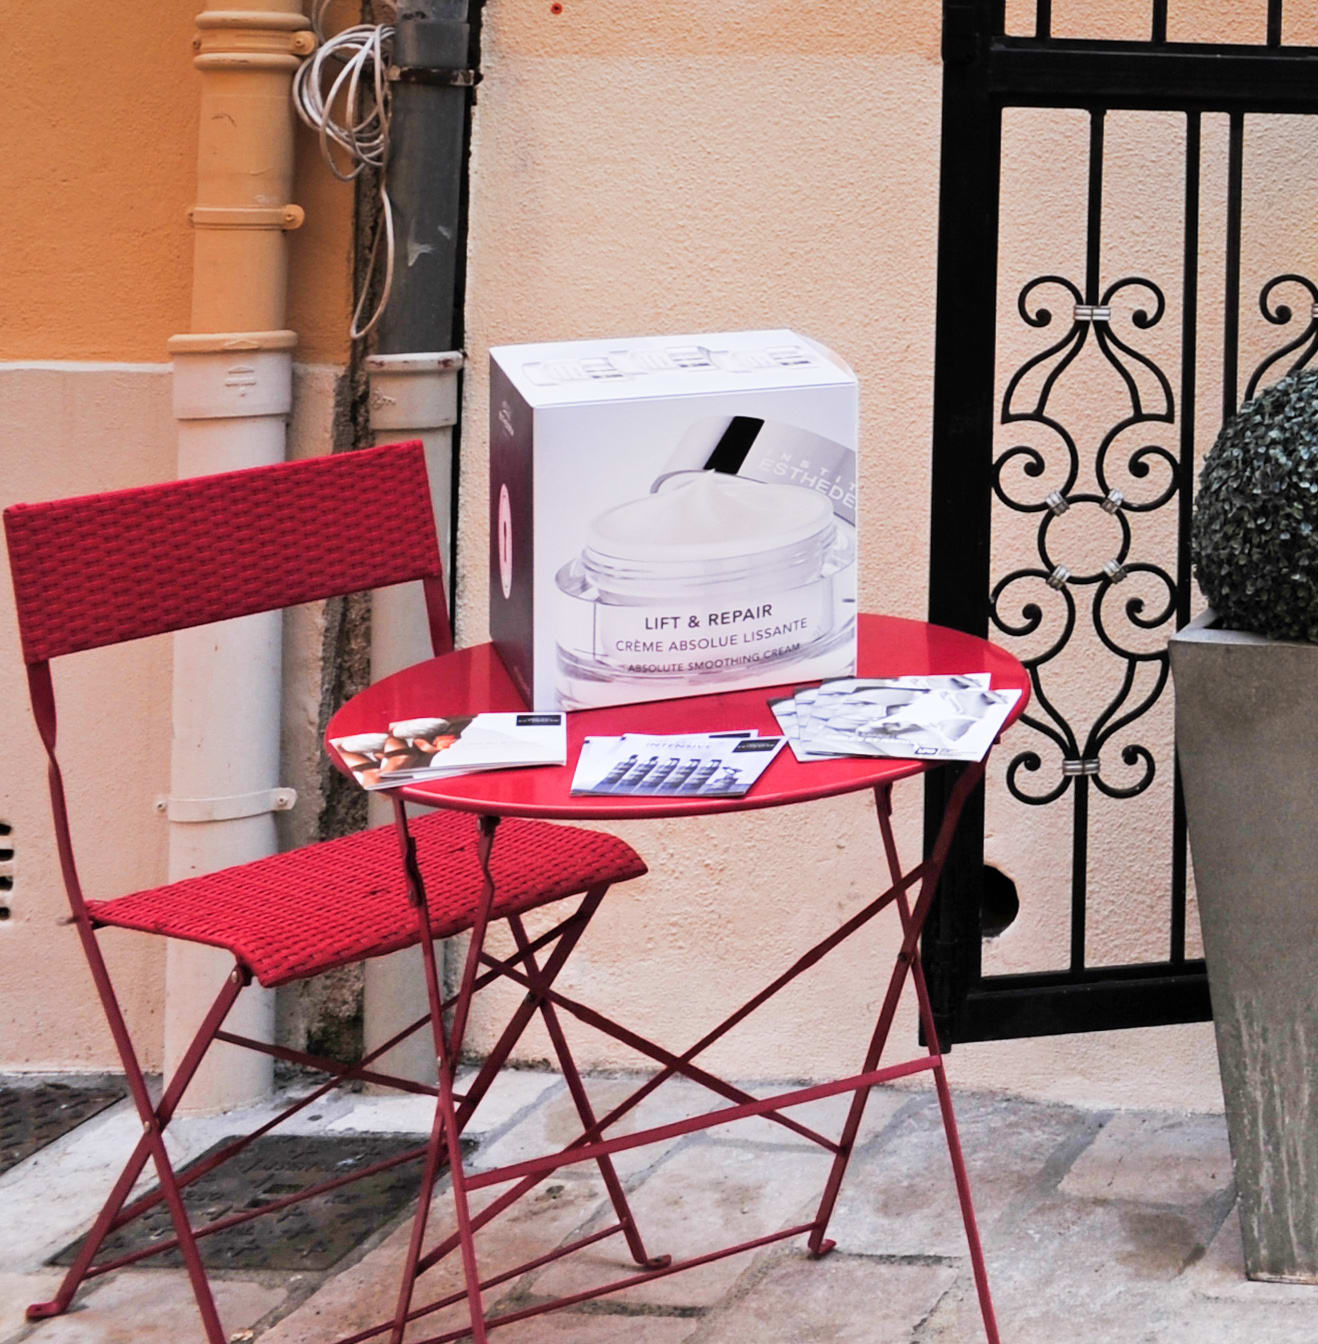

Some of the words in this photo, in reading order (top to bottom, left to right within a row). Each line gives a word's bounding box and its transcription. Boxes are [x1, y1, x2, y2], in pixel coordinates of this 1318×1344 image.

[645, 616, 680, 630] LIFT
[688, 615, 700, 628] &
[708, 604, 773, 626] REPAIR
[616, 639, 663, 652] CRÈME
[668, 634, 738, 651] ABSOLUE
[743, 617, 808, 643] LISSANTE
[628, 662, 684, 673] ABSOLUTE
[687, 652, 760, 672] SMOOTHING
[763, 642, 801, 660] CREAM
